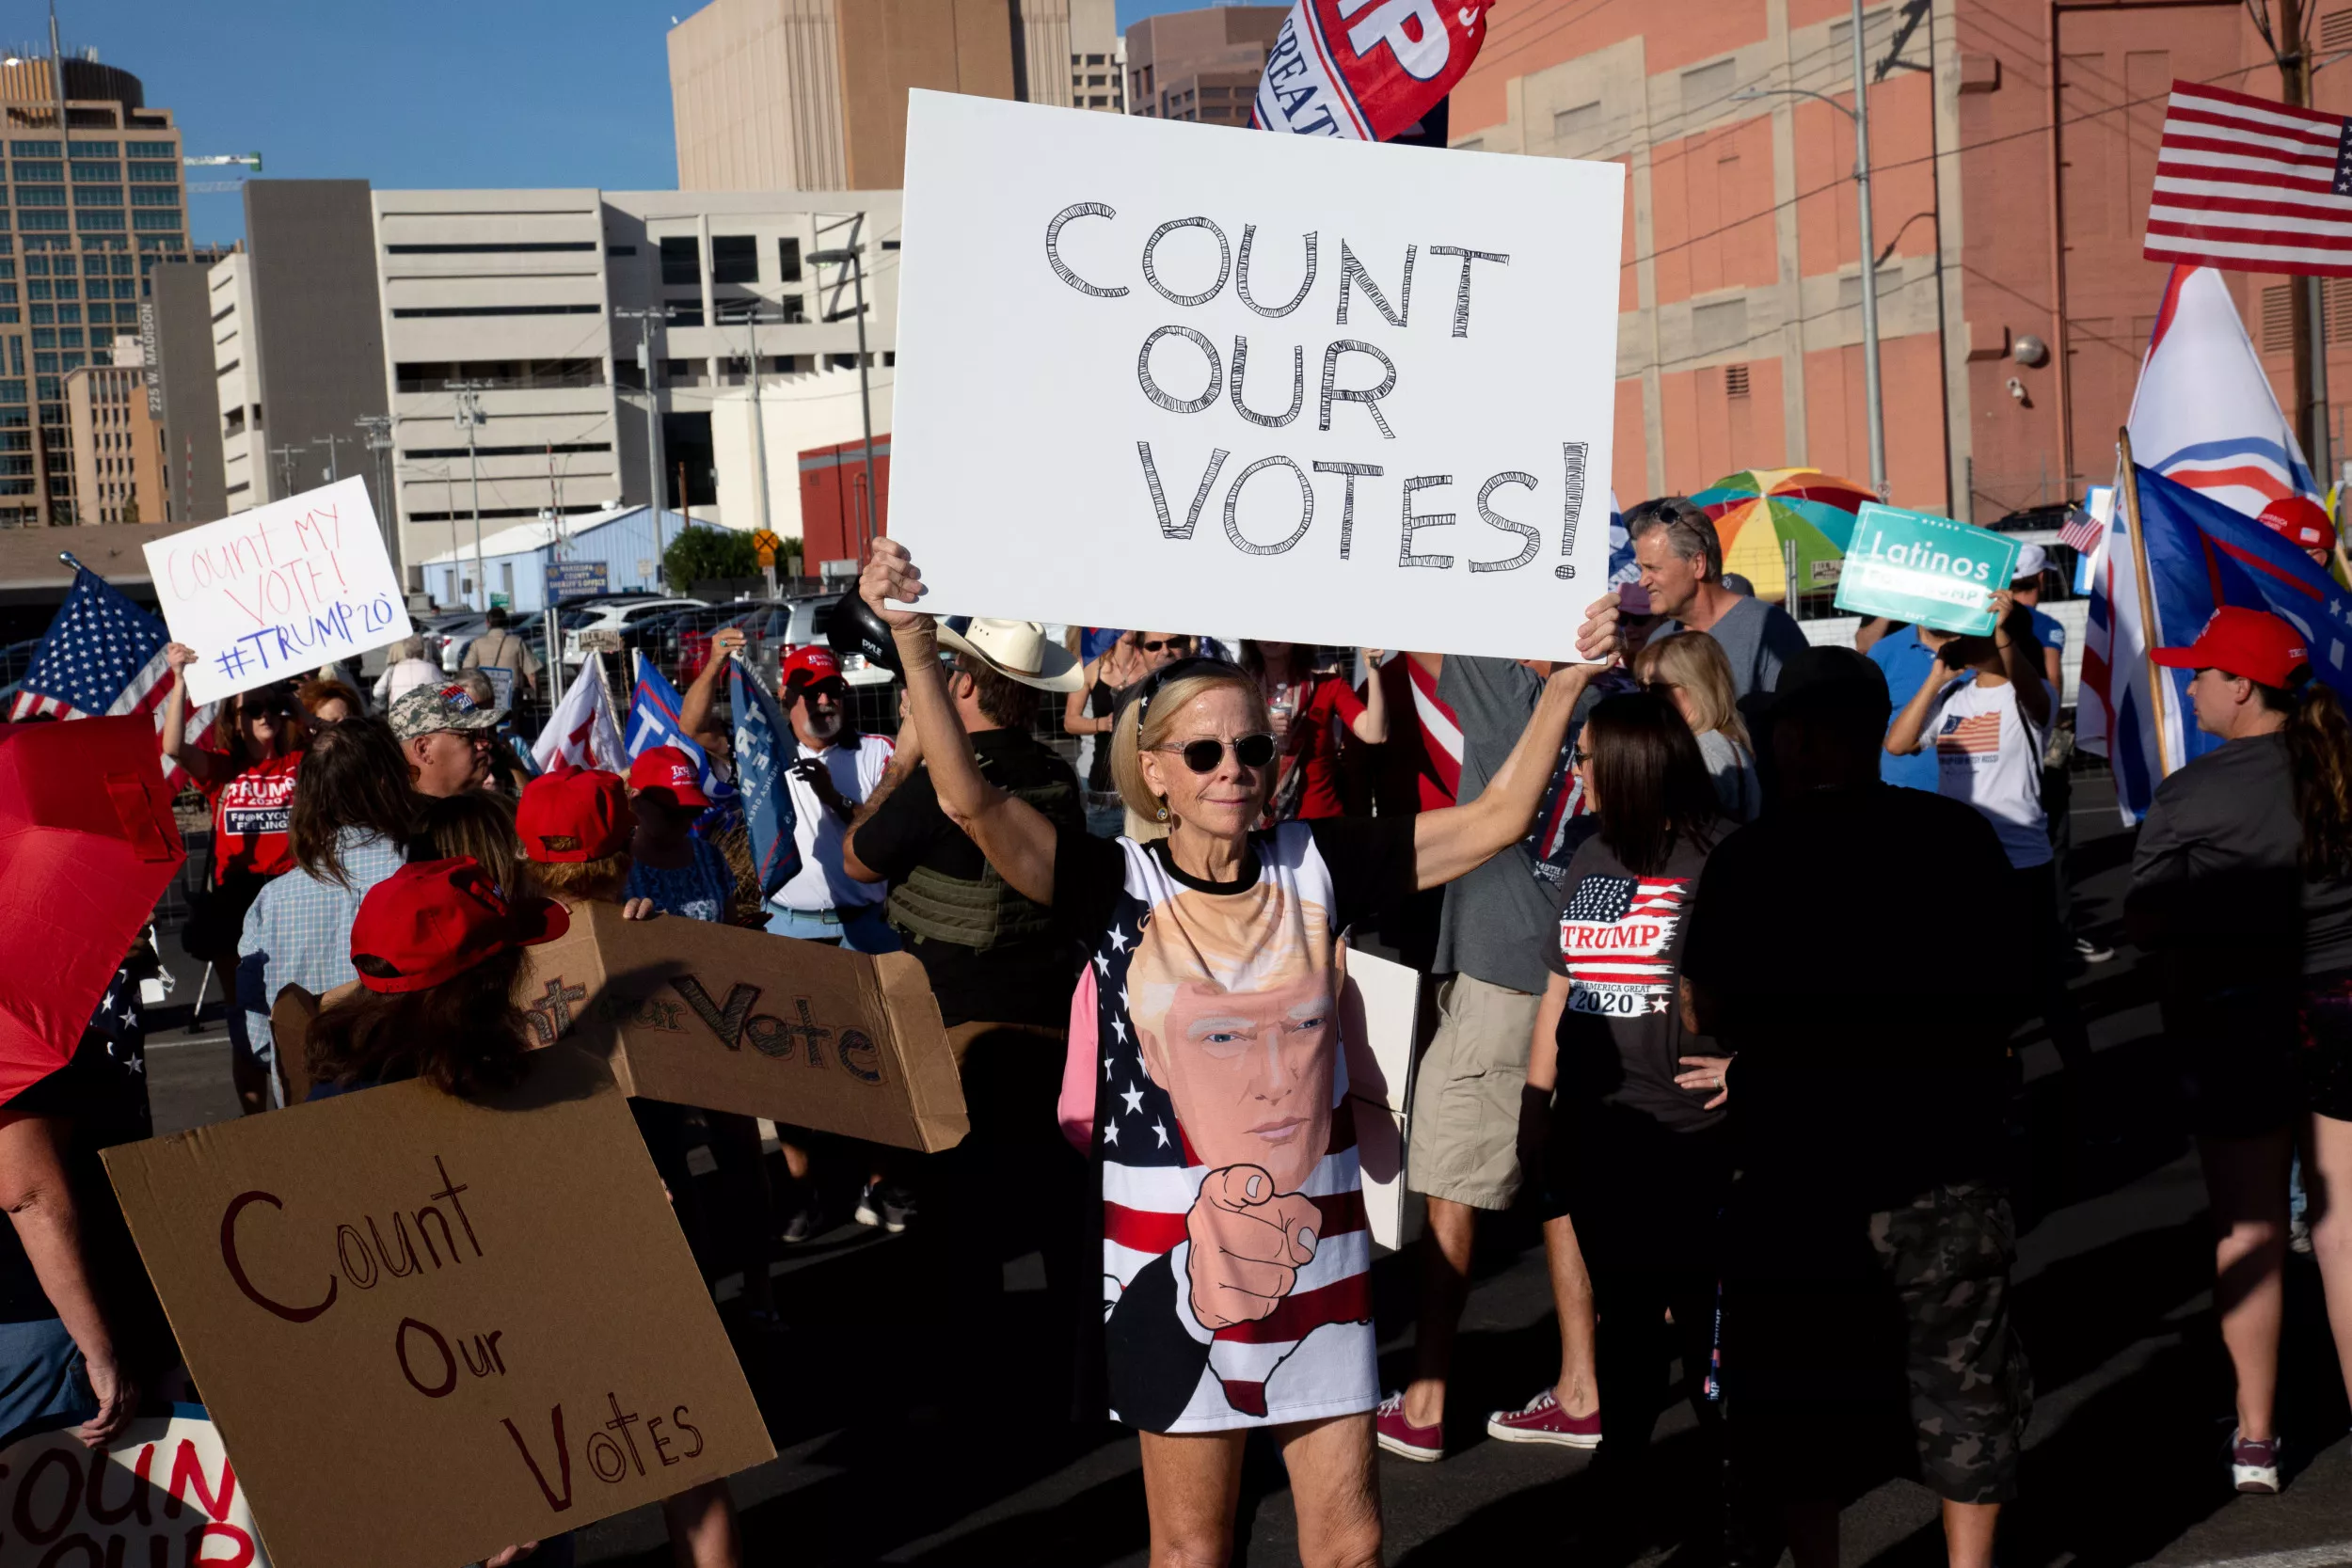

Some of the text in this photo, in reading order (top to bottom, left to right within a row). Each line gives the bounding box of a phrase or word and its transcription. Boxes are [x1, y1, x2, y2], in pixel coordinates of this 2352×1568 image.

[1046, 202, 1510, 338] COUNT
[142, 304, 157, 365] MADISON
[149, 388, 162, 411] 225
[1137, 325, 1396, 438] OUR
[294, 504, 340, 552] MY
[1136, 442, 1588, 580] VOTES!
[1870, 531, 1991, 580] Latinos
[862, 639, 883, 657] PYLE
[229, 777, 296, 798] TRUMP
[237, 820, 290, 830] FEELING
[266, 811, 290, 820] YOU
[1562, 925, 1661, 949] TRUMP
[1575, 990, 1633, 1013] 2020
[1626, 985, 1651, 993] GREAT
[670, 974, 887, 1086] Vote
[220, 1155, 483, 1323] Count
[396, 1317, 506, 1398] Our
